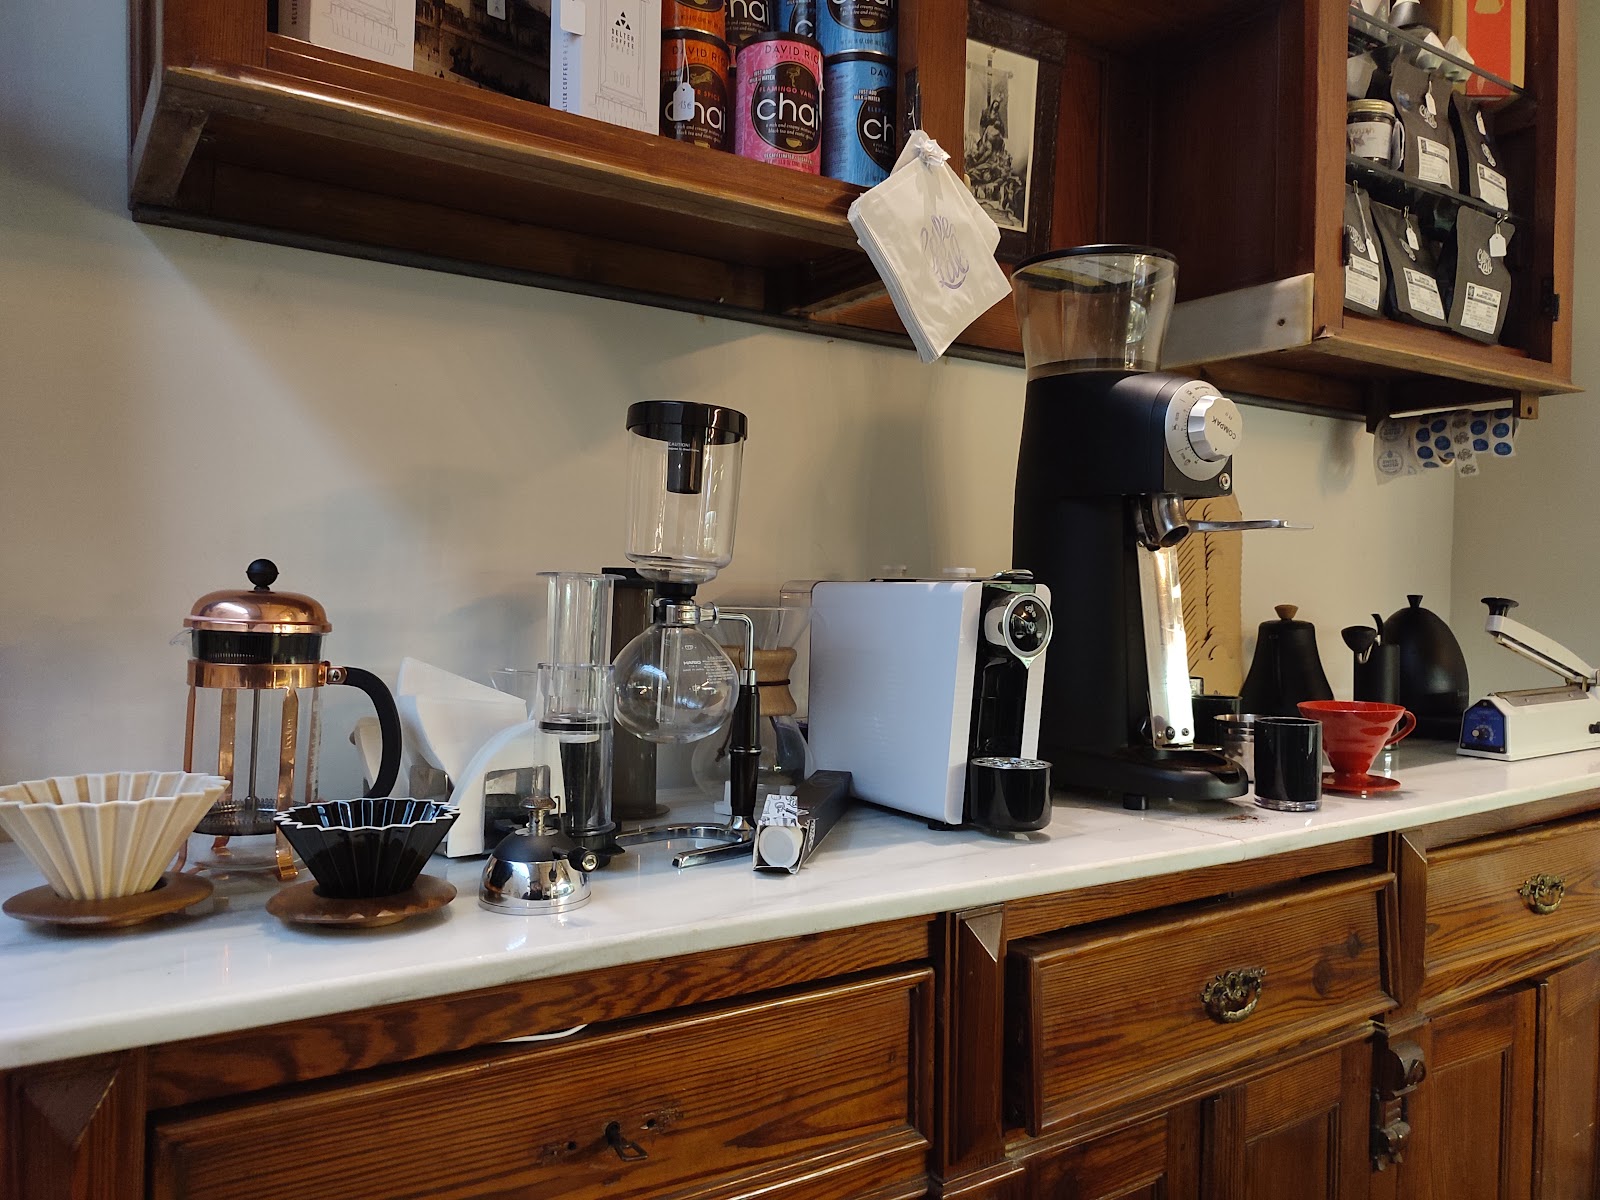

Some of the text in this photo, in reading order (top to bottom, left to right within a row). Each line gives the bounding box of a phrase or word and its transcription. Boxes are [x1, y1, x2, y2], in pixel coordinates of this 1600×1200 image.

[725, 0, 770, 26] hai
[611, 28, 634, 42] DELTER
[611, 36, 634, 50] COFFEE
[765, 45, 800, 56] DAVID
[759, 85, 798, 94] FLAMINGO
[756, 92, 819, 131] chai
[1211, 415, 1237, 441] COMPAK
